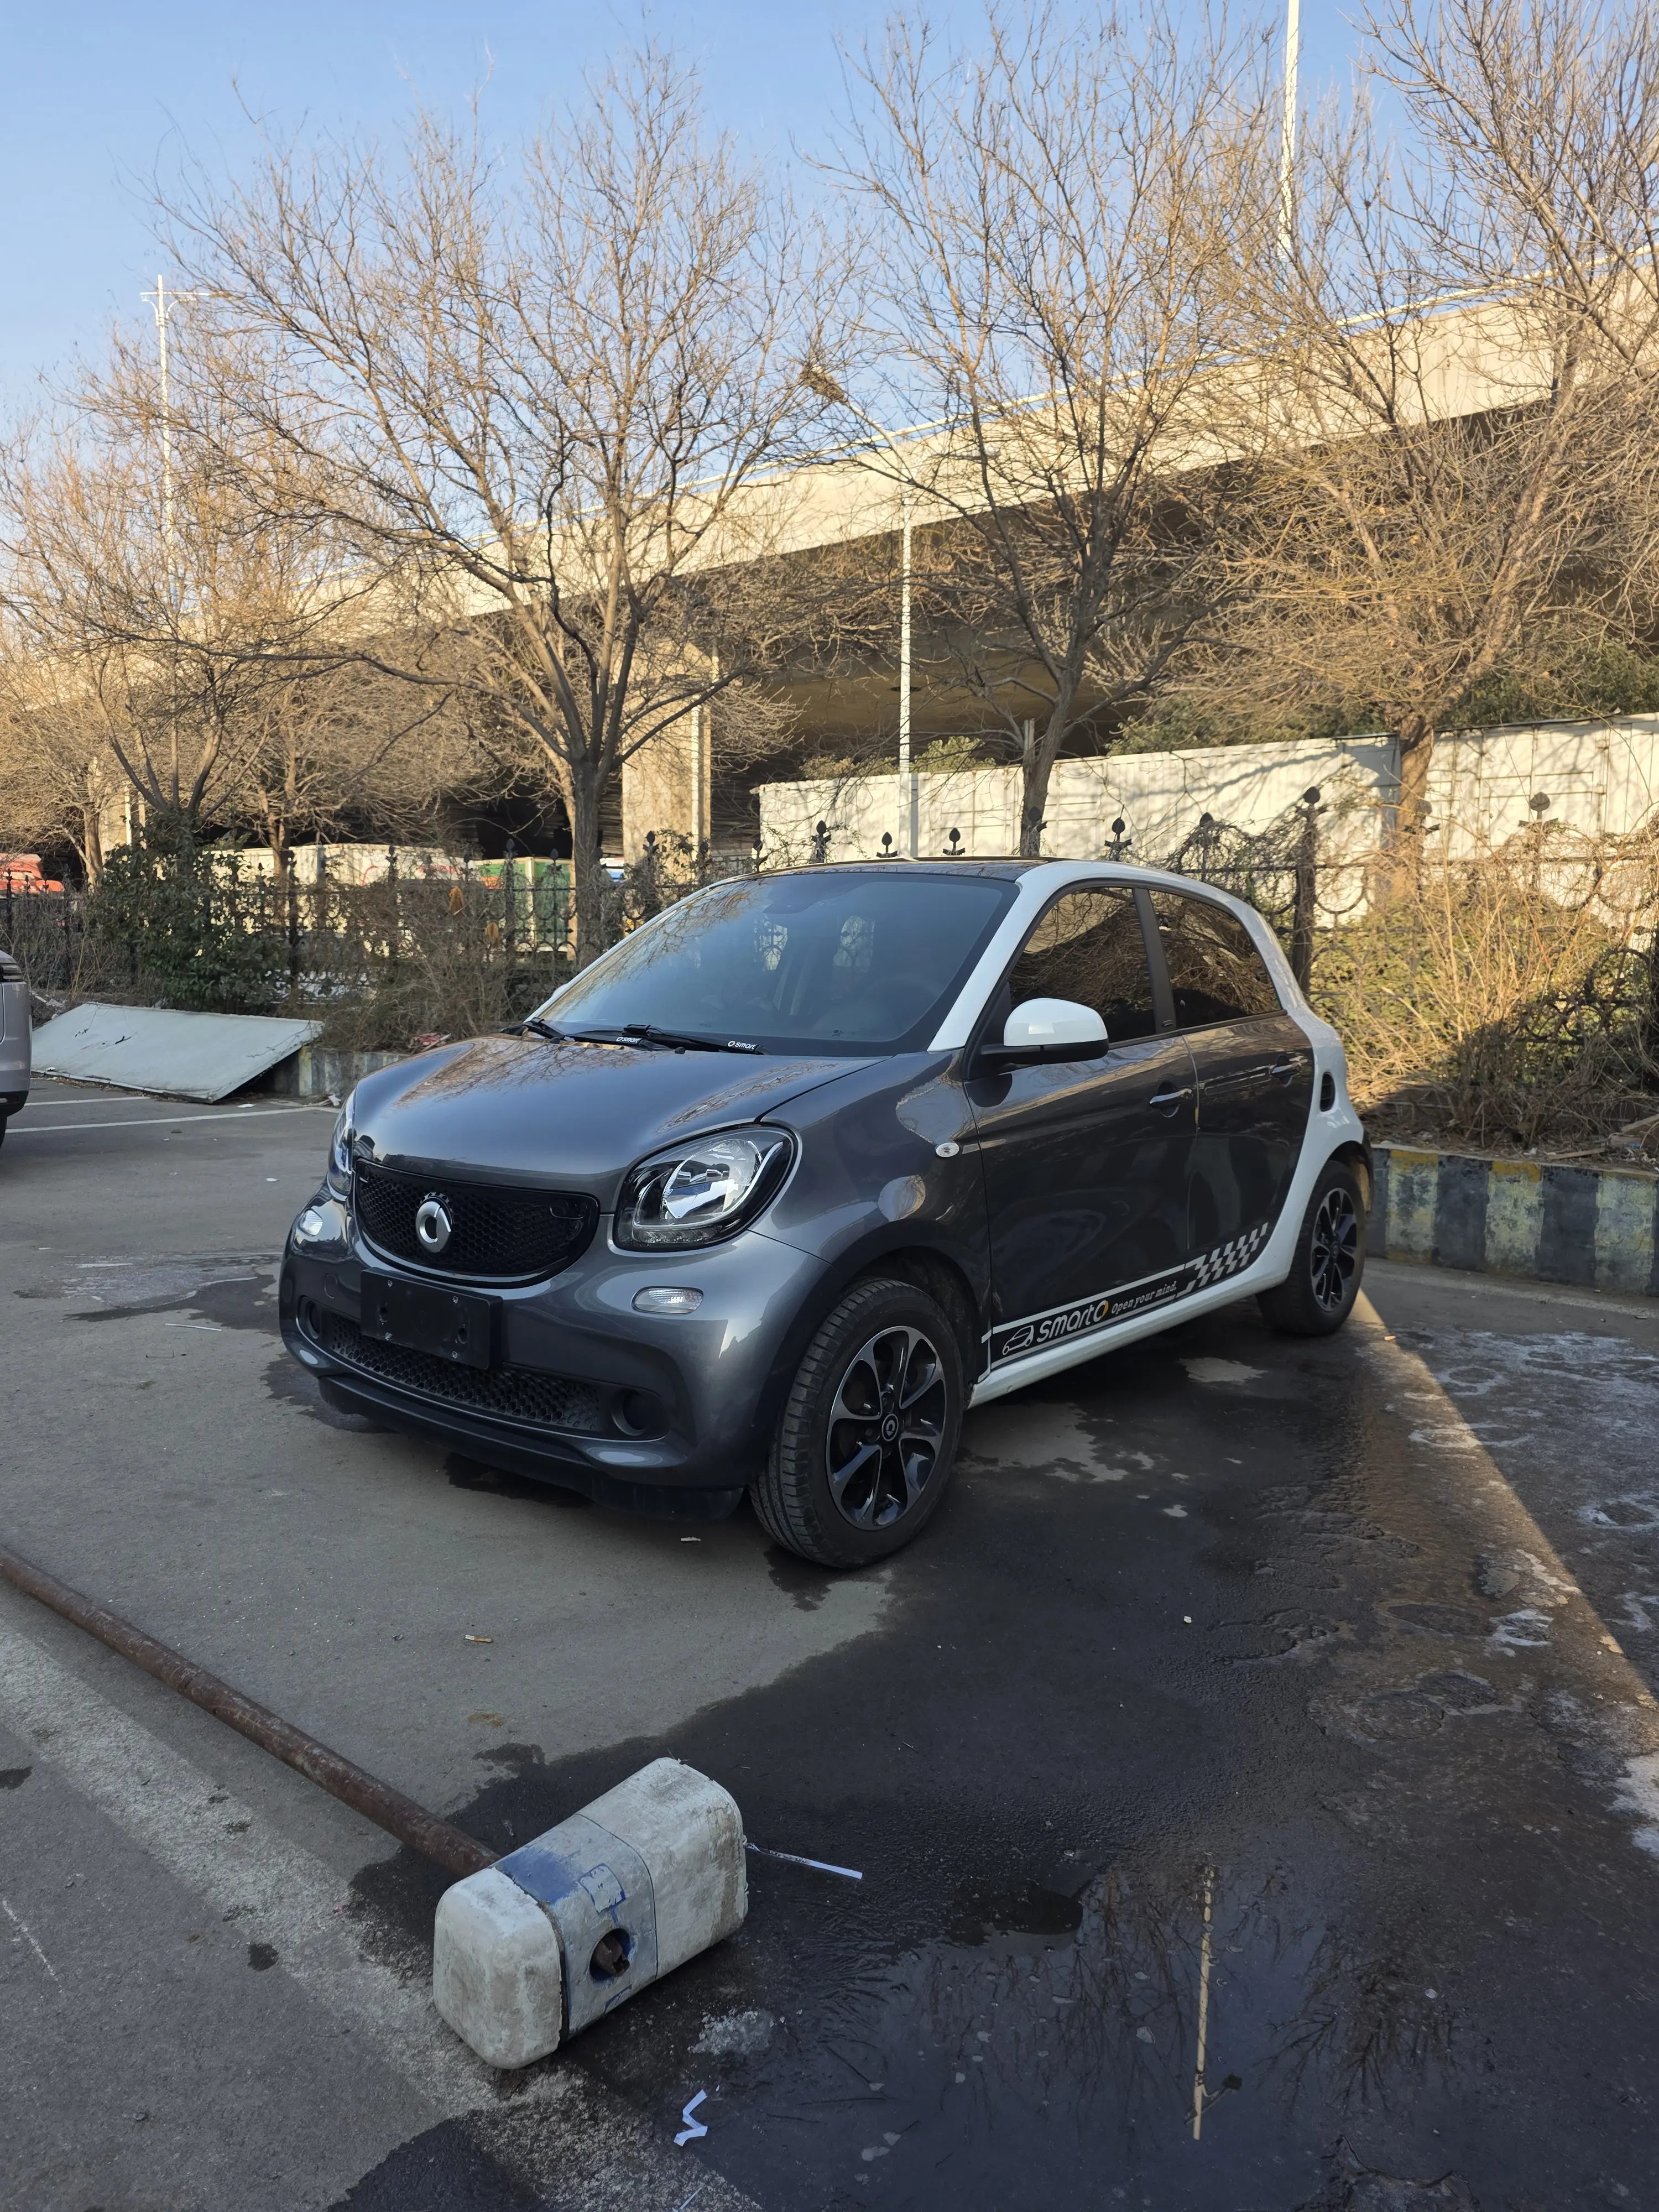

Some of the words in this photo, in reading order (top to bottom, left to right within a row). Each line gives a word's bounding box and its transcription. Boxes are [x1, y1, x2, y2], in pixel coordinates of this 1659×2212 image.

[735, 1042, 756, 1050] smart
[1036, 1305, 1095, 1343] smart
[1133, 1291, 1155, 1308] your
